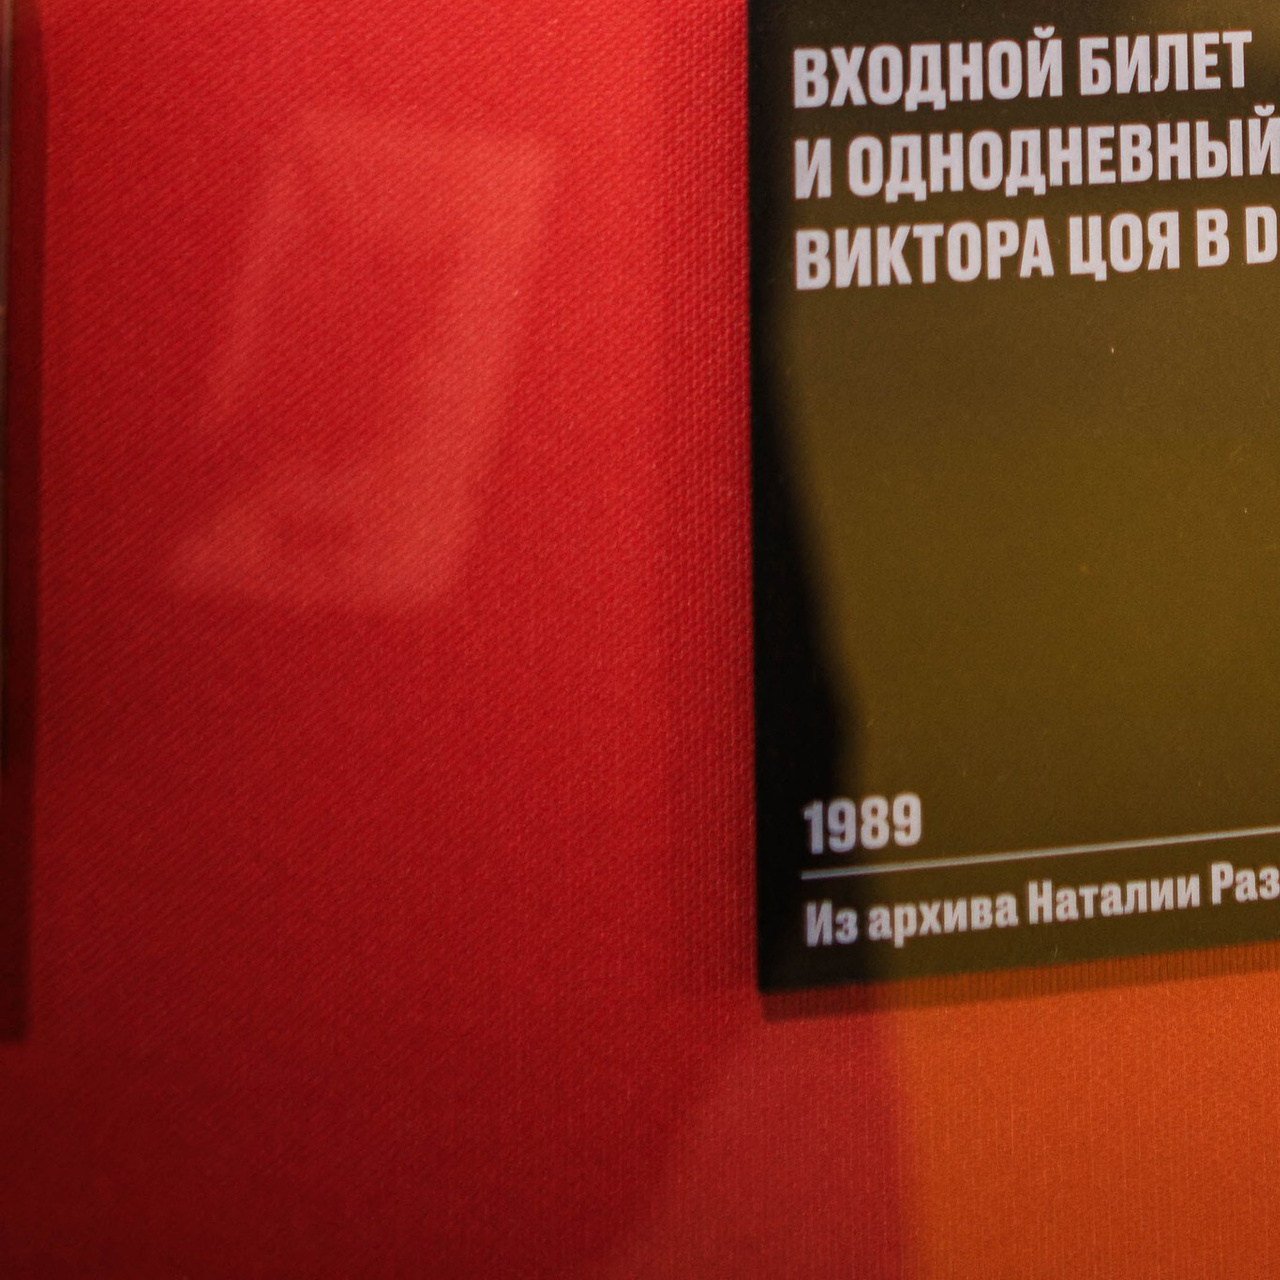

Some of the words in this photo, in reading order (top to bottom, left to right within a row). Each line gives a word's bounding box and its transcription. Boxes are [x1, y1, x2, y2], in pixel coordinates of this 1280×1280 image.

[793, 26, 1064, 112] ВХОДНОЙ
[1080, 29, 1253, 98] БИЛЕТ
[794, 138, 833, 200] И
[794, 218, 1054, 291] ВИКТОРА
[1068, 211, 1180, 282] ЦОЯ
[1198, 208, 1230, 268] В
[802, 792, 923, 855] 1989
[805, 900, 858, 948] Из
[868, 892, 1019, 948] архива
[1028, 874, 1201, 925] Наталии
